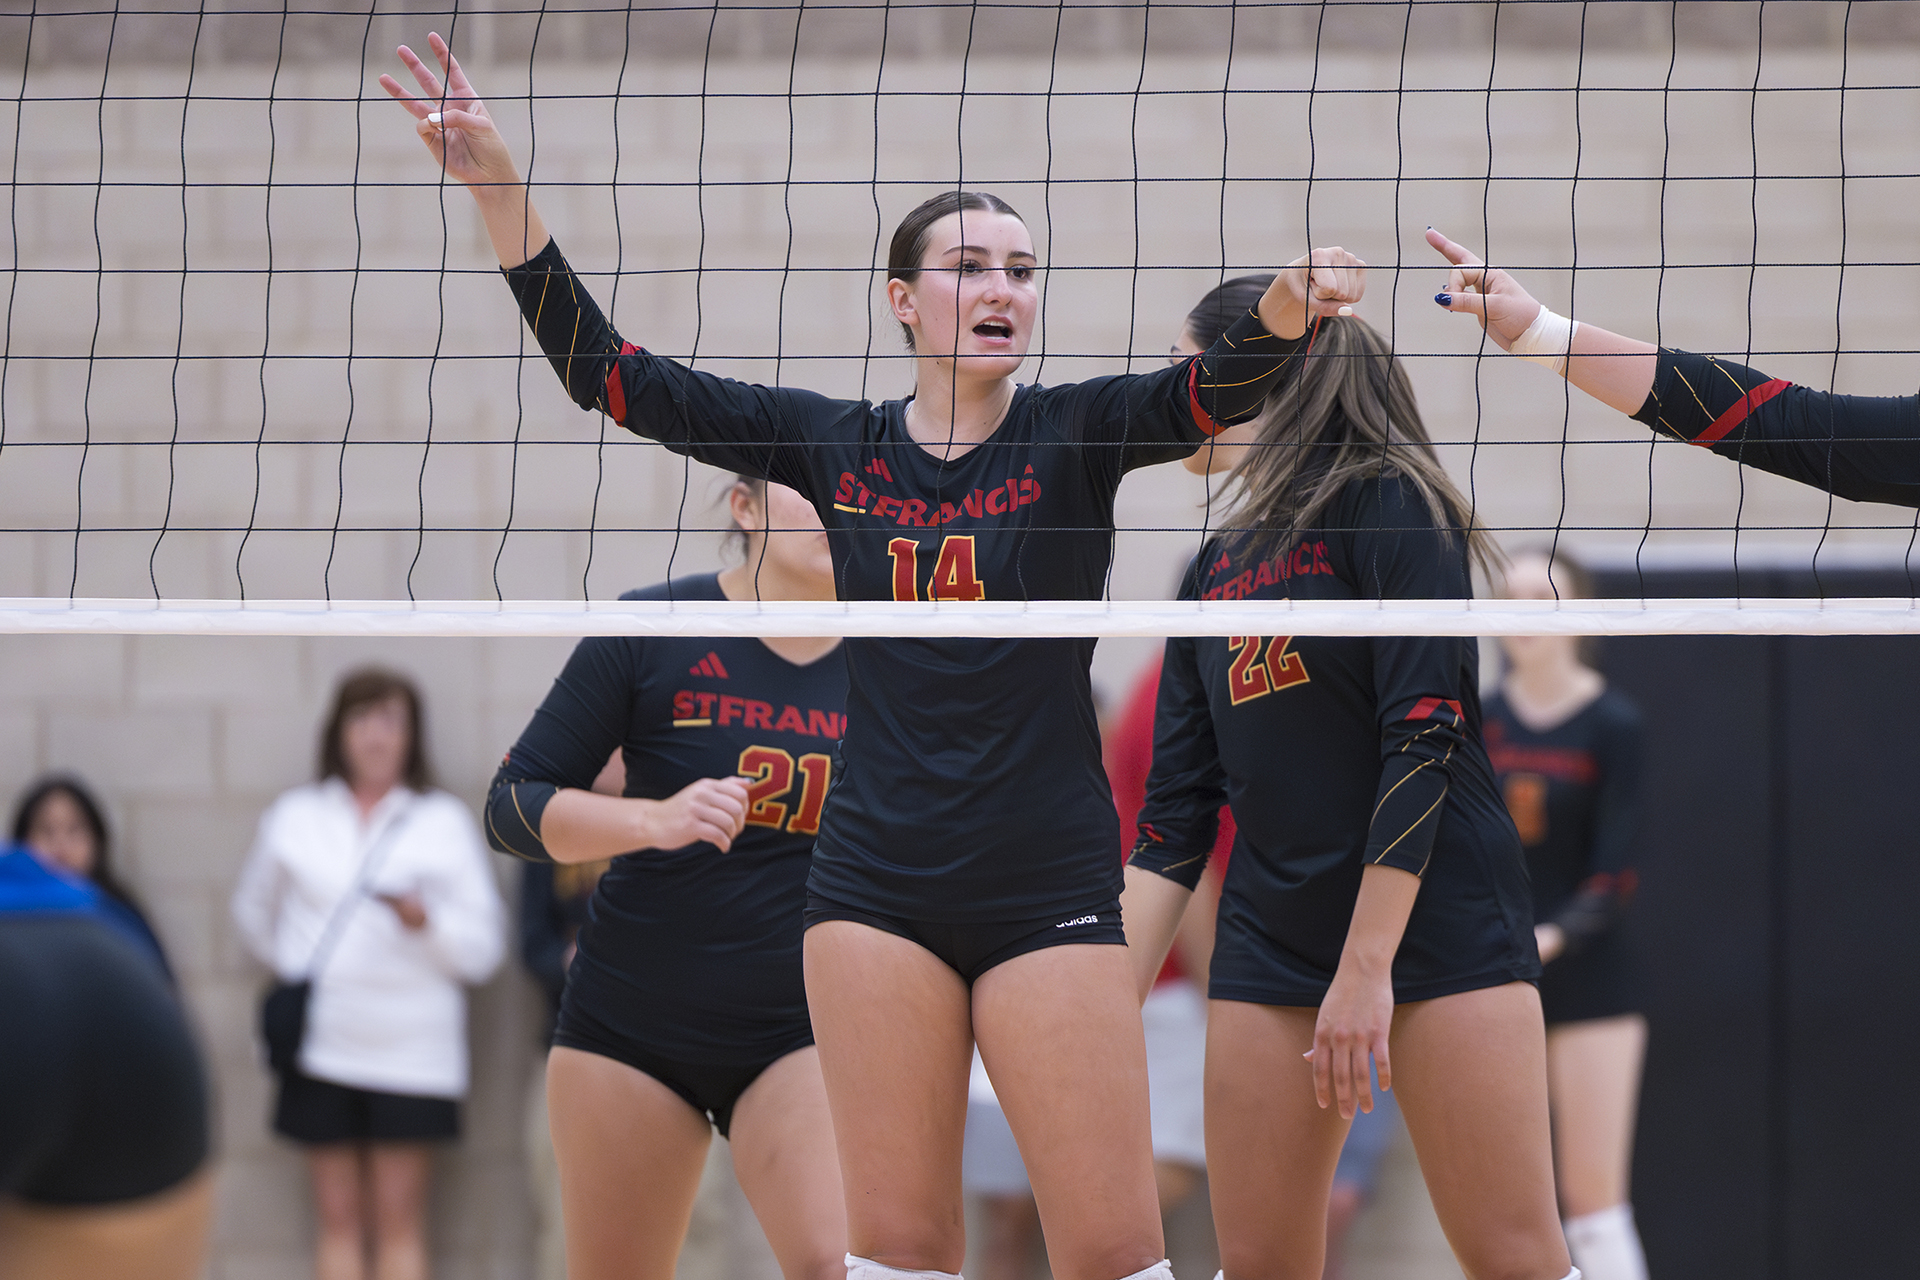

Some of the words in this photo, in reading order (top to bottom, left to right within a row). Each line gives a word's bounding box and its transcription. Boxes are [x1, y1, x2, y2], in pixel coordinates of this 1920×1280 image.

[888, 535, 985, 601] 14
[1229, 636, 1311, 706] 22
[717, 694, 848, 740] FRAN
[737, 745, 832, 835] 21
